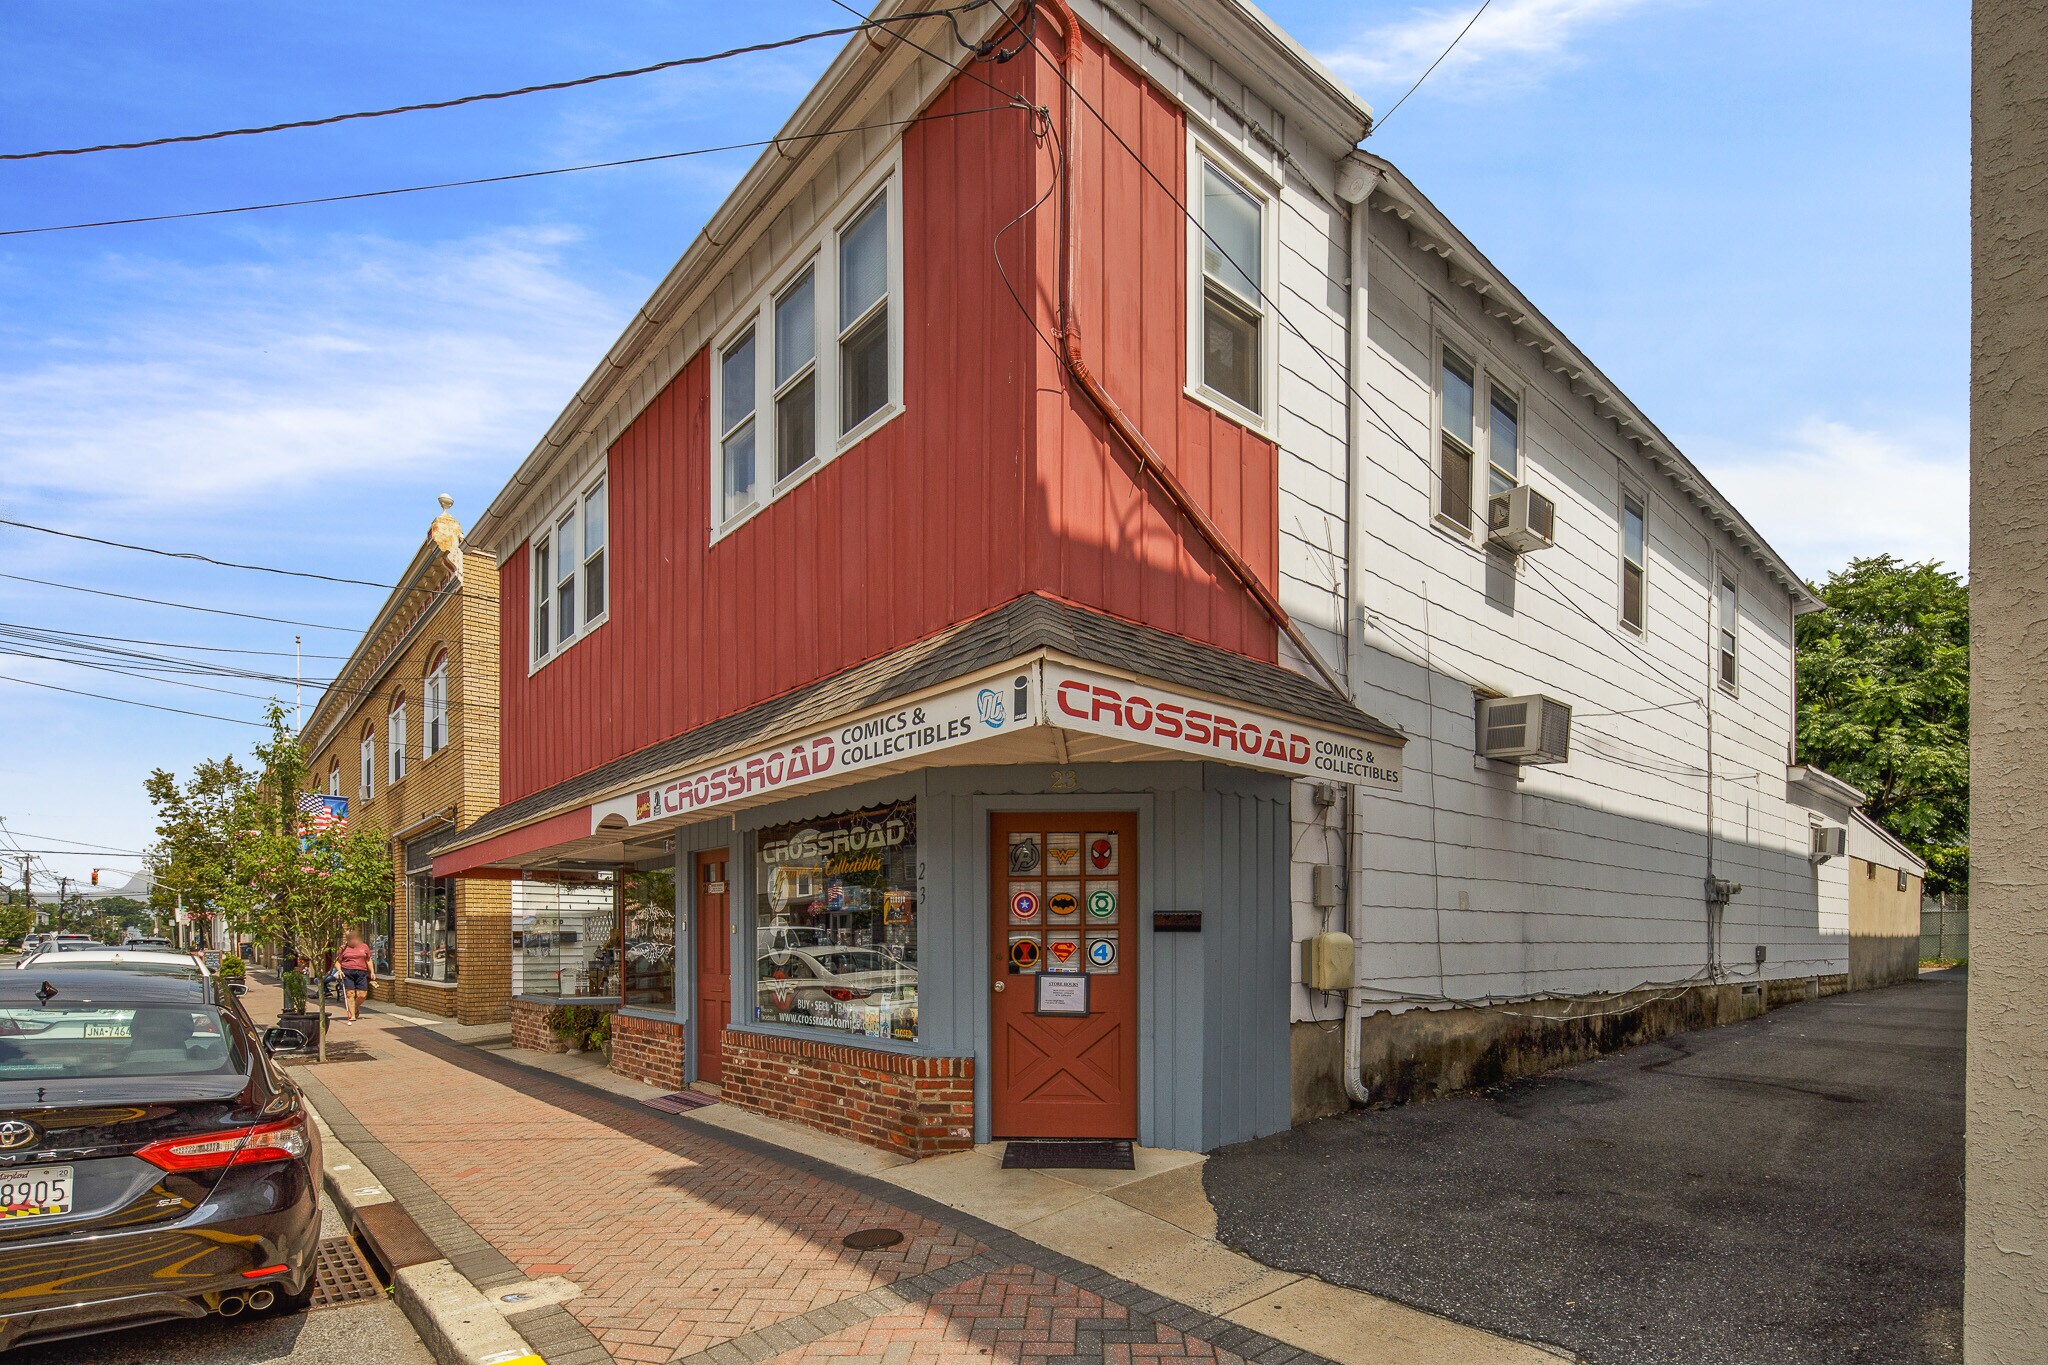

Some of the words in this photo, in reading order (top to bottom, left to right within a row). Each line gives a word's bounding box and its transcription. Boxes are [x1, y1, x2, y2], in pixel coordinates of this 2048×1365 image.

[841, 714, 908, 746] COMICS
[911, 707, 926, 726] &
[1057, 680, 1311, 765] CROSSROAD
[841, 716, 972, 766] COLLECTIBLES
[1315, 740, 1364, 762] COMICS
[1366, 751, 1375, 764] &
[664, 736, 835, 813] CROSSROAD
[1051, 769, 1078, 789] 23
[1314, 756, 1399, 783] COLLECTIBLES
[762, 819, 905, 864] CROSSROAD
[825, 853, 881, 877] Collectibles
[797, 999, 810, 1010] BUY
[814, 1000, 829, 1012] SELL
[0, 1179, 66, 1207] 8905
[155, 1197, 183, 1208] SE
